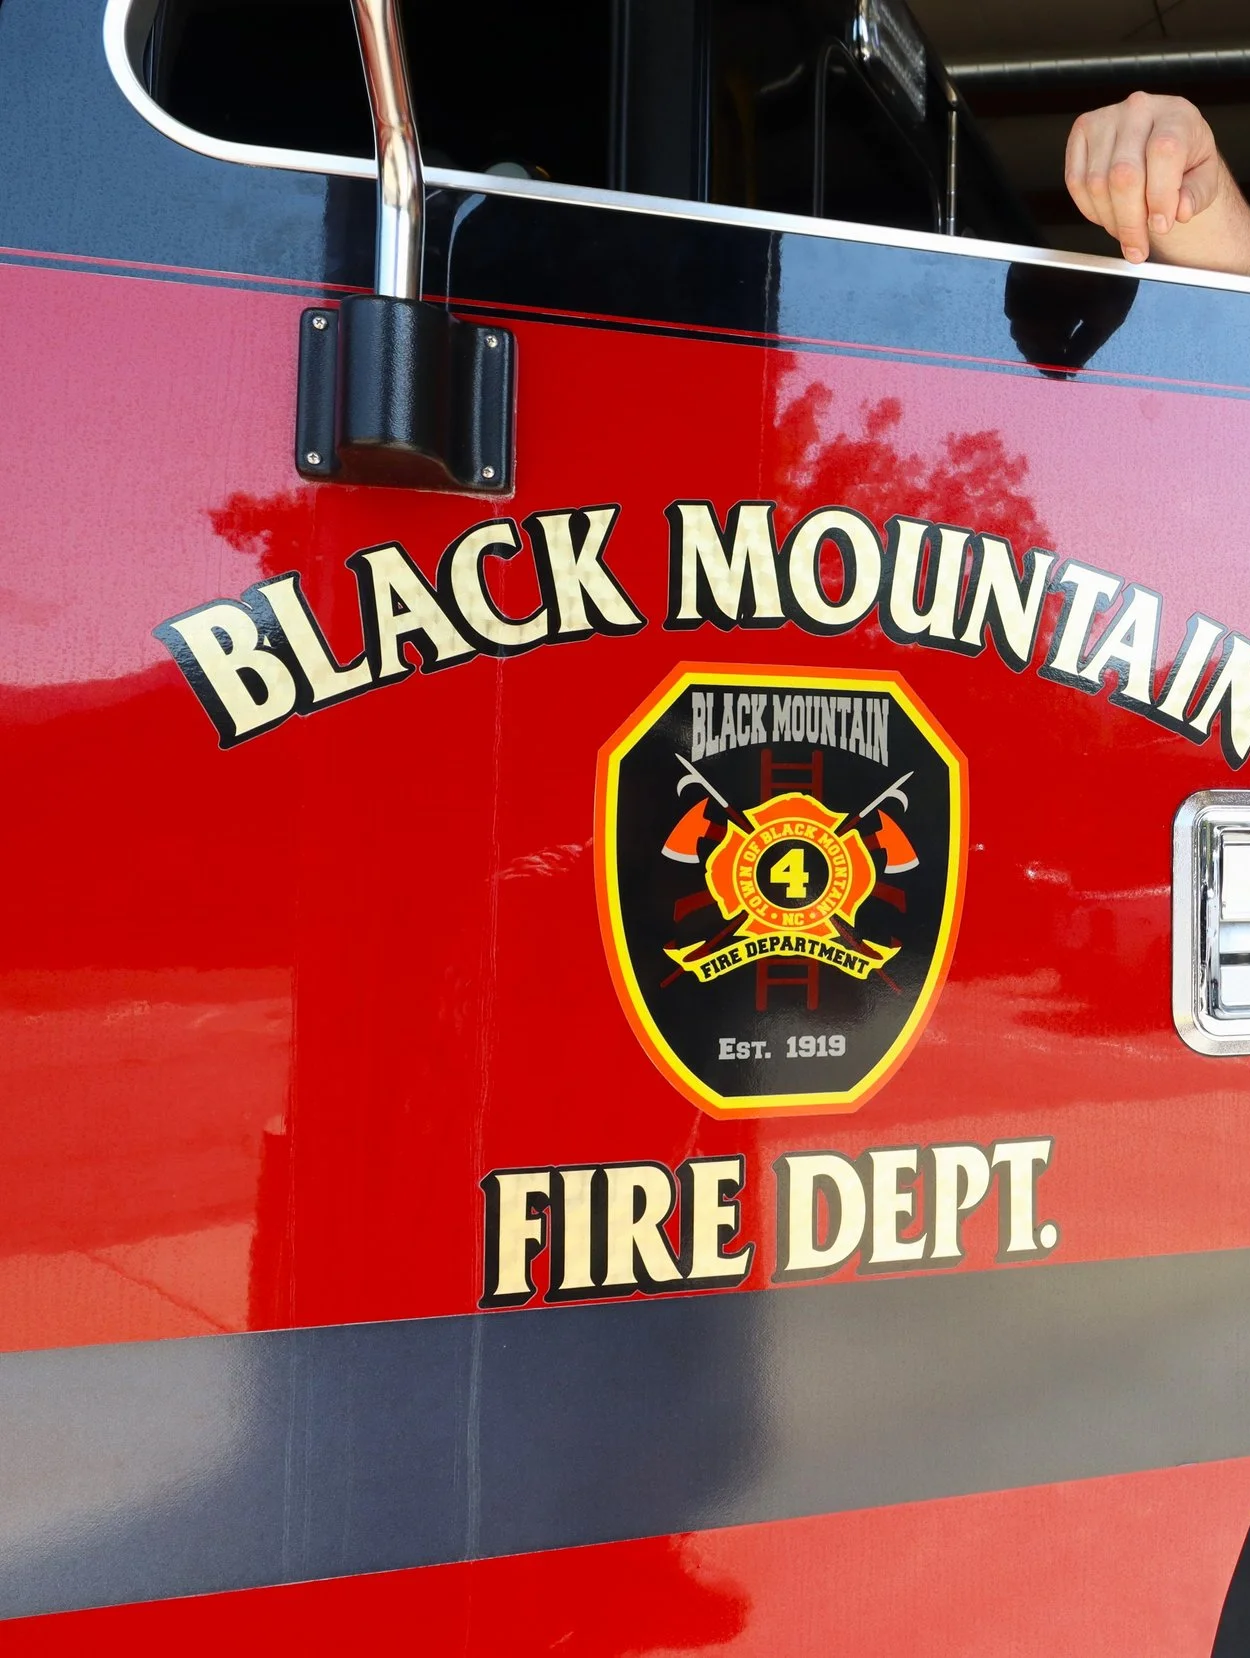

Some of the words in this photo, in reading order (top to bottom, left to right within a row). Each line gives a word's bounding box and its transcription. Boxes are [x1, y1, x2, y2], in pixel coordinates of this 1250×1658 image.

[154, 502, 648, 750] BLACK
[691, 692, 767, 763] BLACK
[772, 694, 889, 768] MOUNTAIN
[743, 841, 761, 863] OF
[759, 823, 818, 845] BLACK
[739, 865, 769, 917] TOWN
[769, 848, 810, 899] 4
[816, 832, 848, 916] MOUNTAIN
[781, 912, 805, 926] NC
[700, 948, 743, 979] FIRE
[744, 936, 870, 975] DEPARTMENT
[786, 1034, 846, 1059] 1919
[479, 1154, 755, 1308] FIRE
[771, 1134, 1062, 1283] DEPT.
